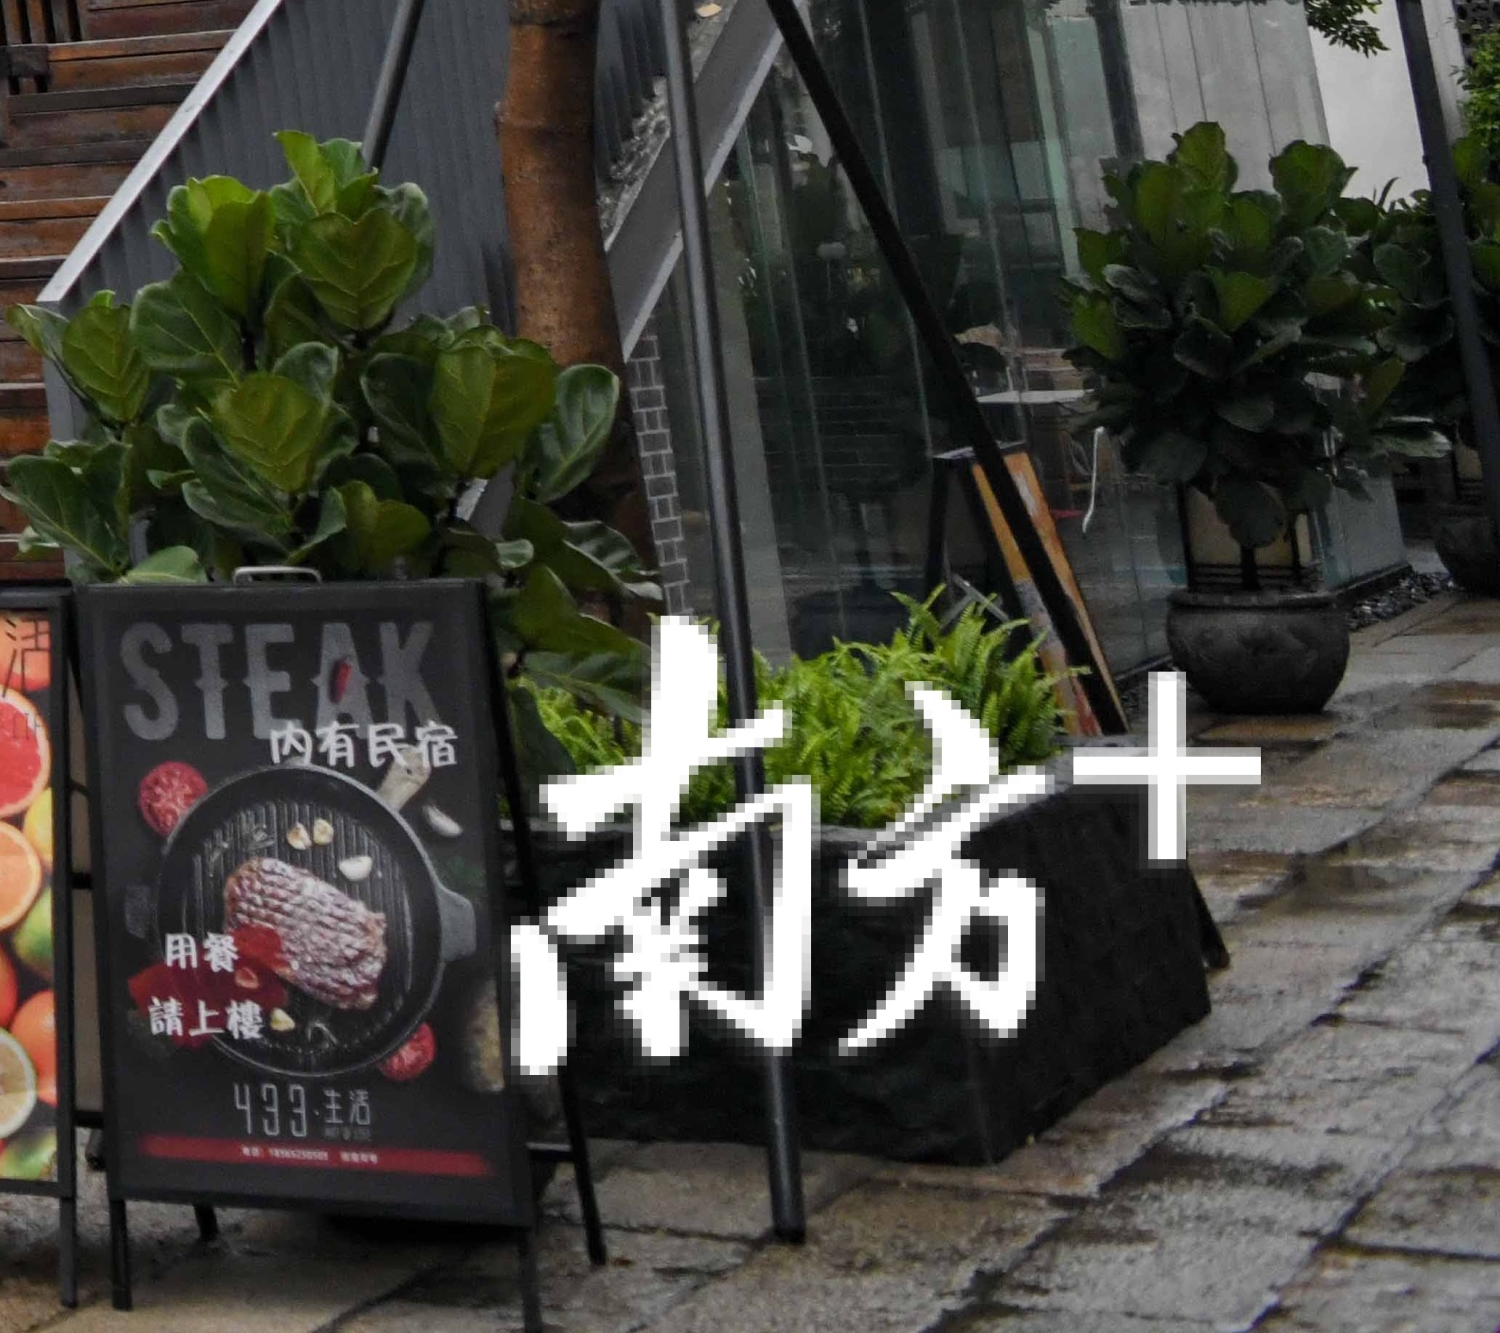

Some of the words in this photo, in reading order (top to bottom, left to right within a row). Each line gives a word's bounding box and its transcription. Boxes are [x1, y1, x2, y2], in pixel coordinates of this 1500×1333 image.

[119, 621, 442, 741] STEAK
[269, 719, 458, 768] 内有民宿
[165, 932, 238, 973] 用餐
[148, 996, 263, 1040] 請上樓
[234, 1083, 371, 1137] 433·生活
